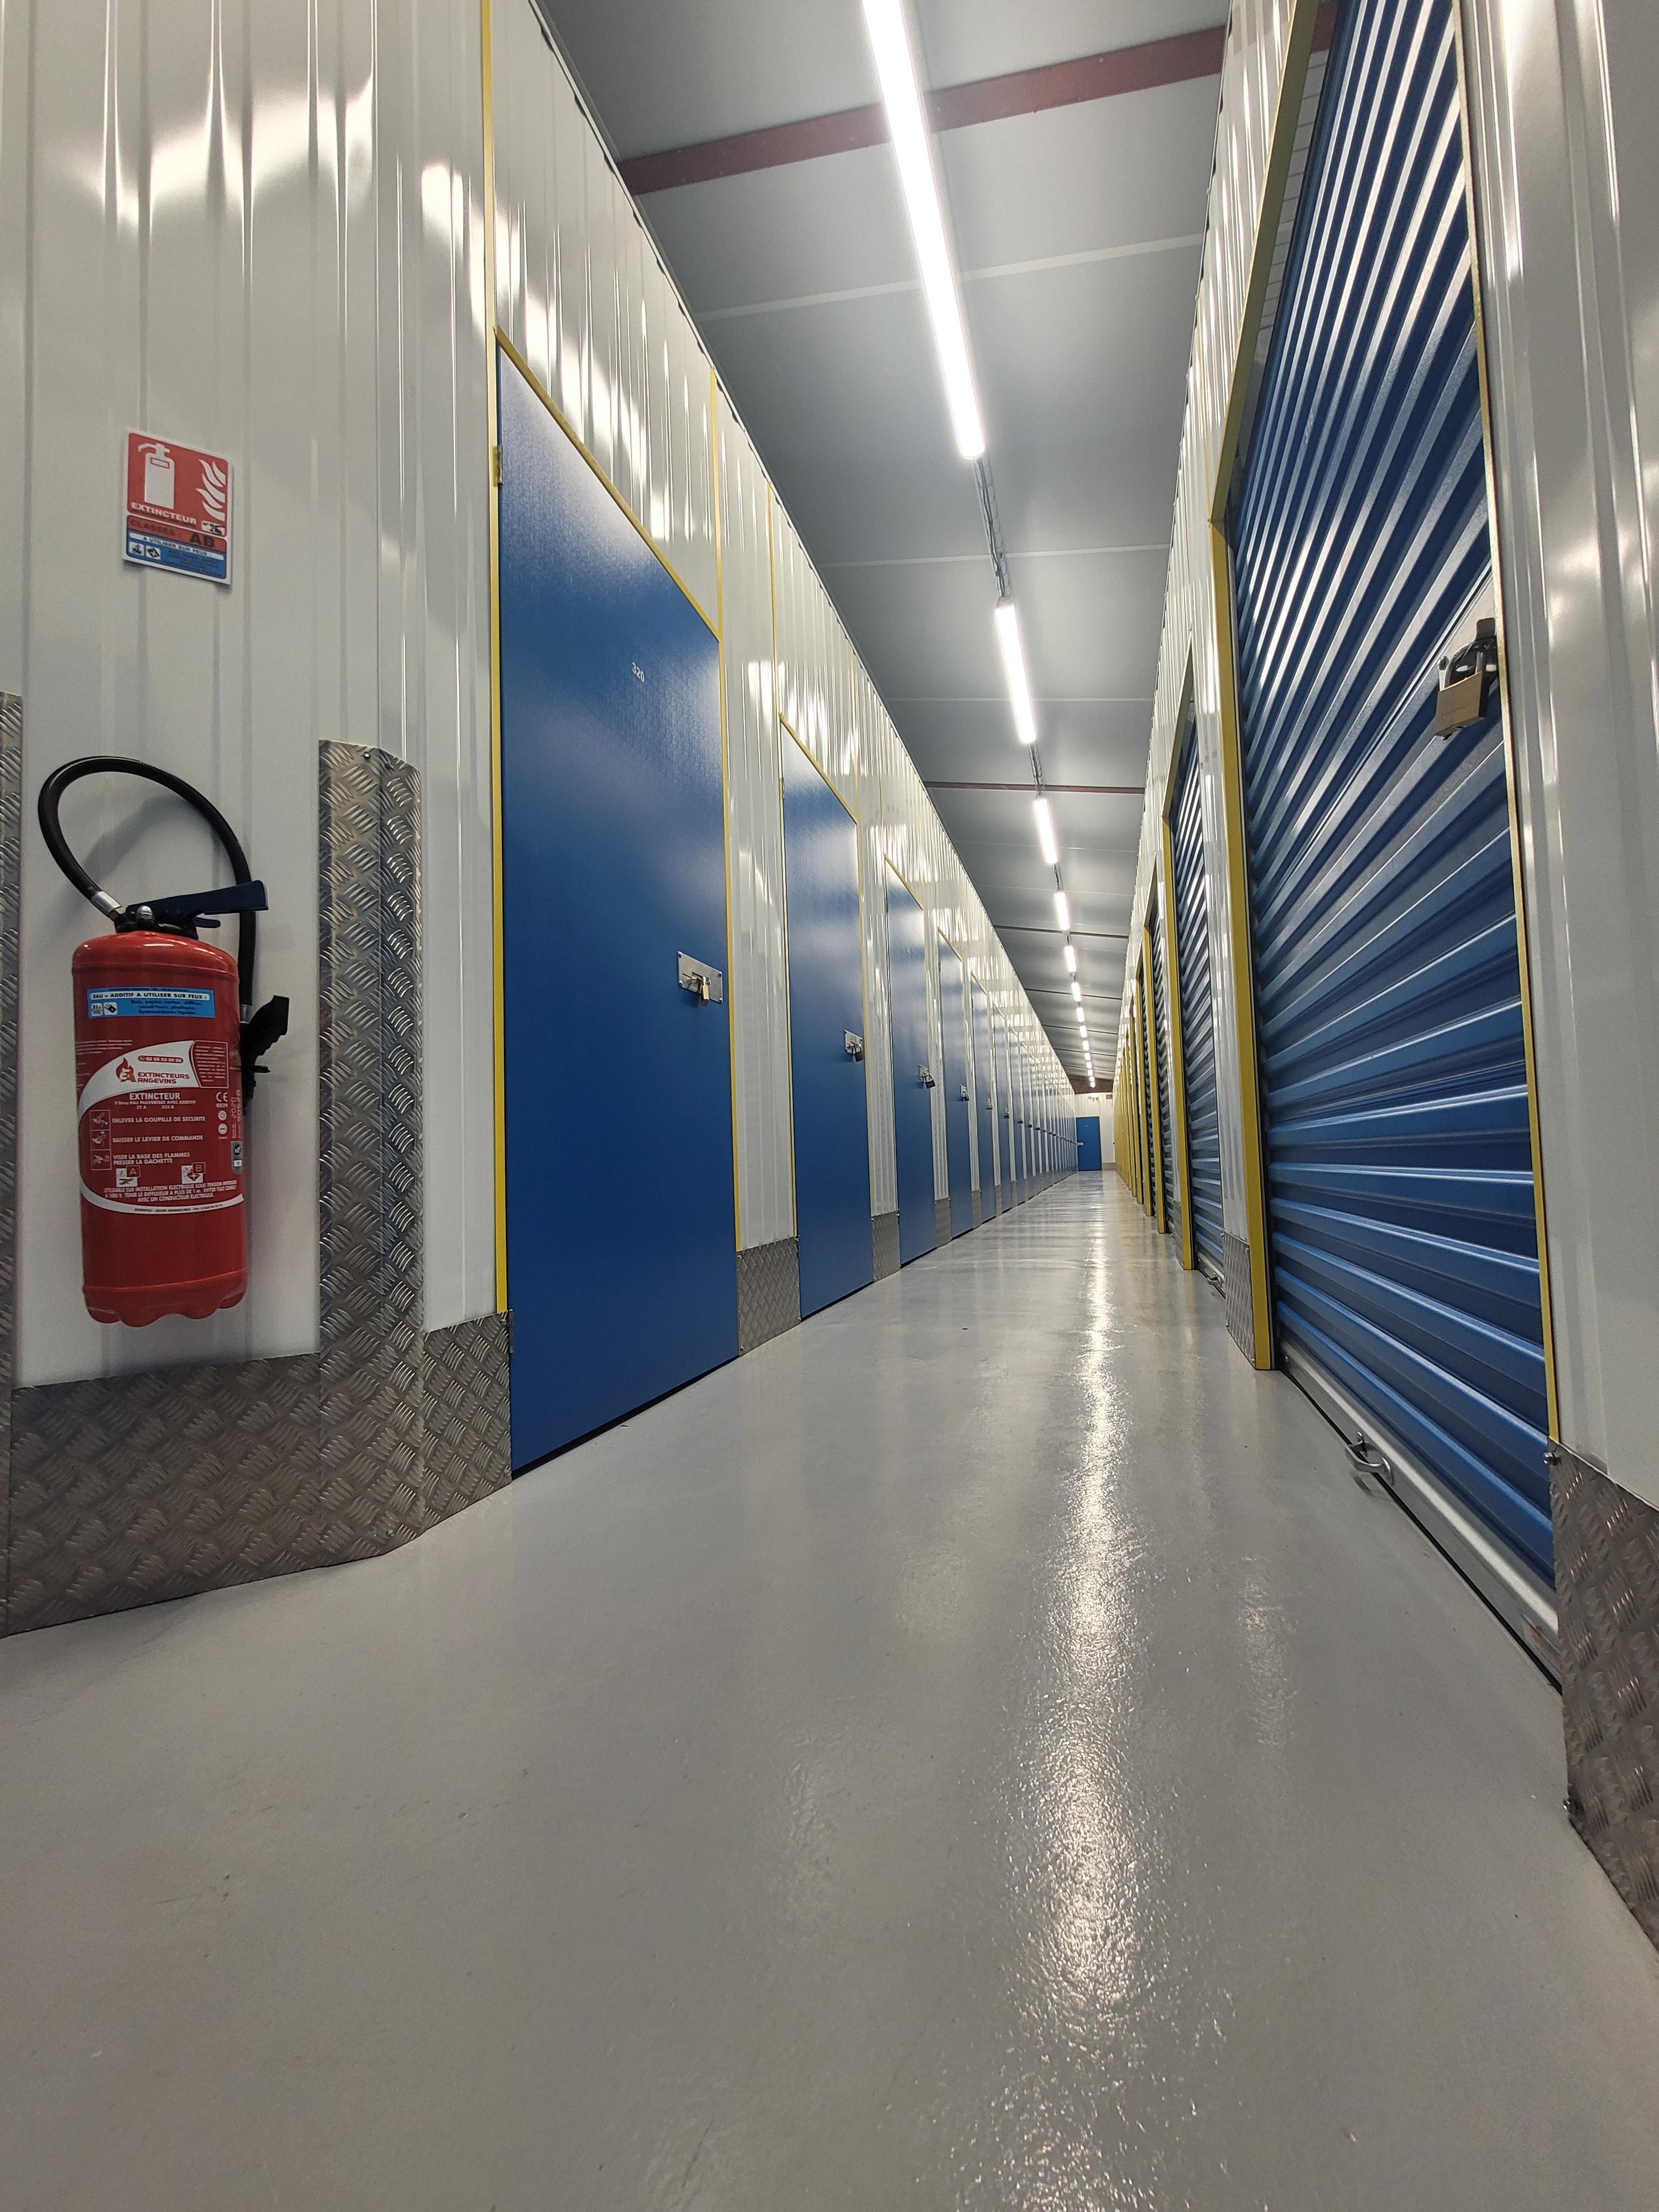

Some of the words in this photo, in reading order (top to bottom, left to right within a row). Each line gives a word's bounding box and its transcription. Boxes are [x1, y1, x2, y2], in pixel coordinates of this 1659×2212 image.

[132, 502, 196, 525] EXTINCTEUR
[131, 520, 175, 536] CLASSES
[190, 533, 215, 547] AB
[150, 538, 176, 548] UTILISER
[633, 662, 644, 682] 320
[216, 1092, 228, 1102] CE
